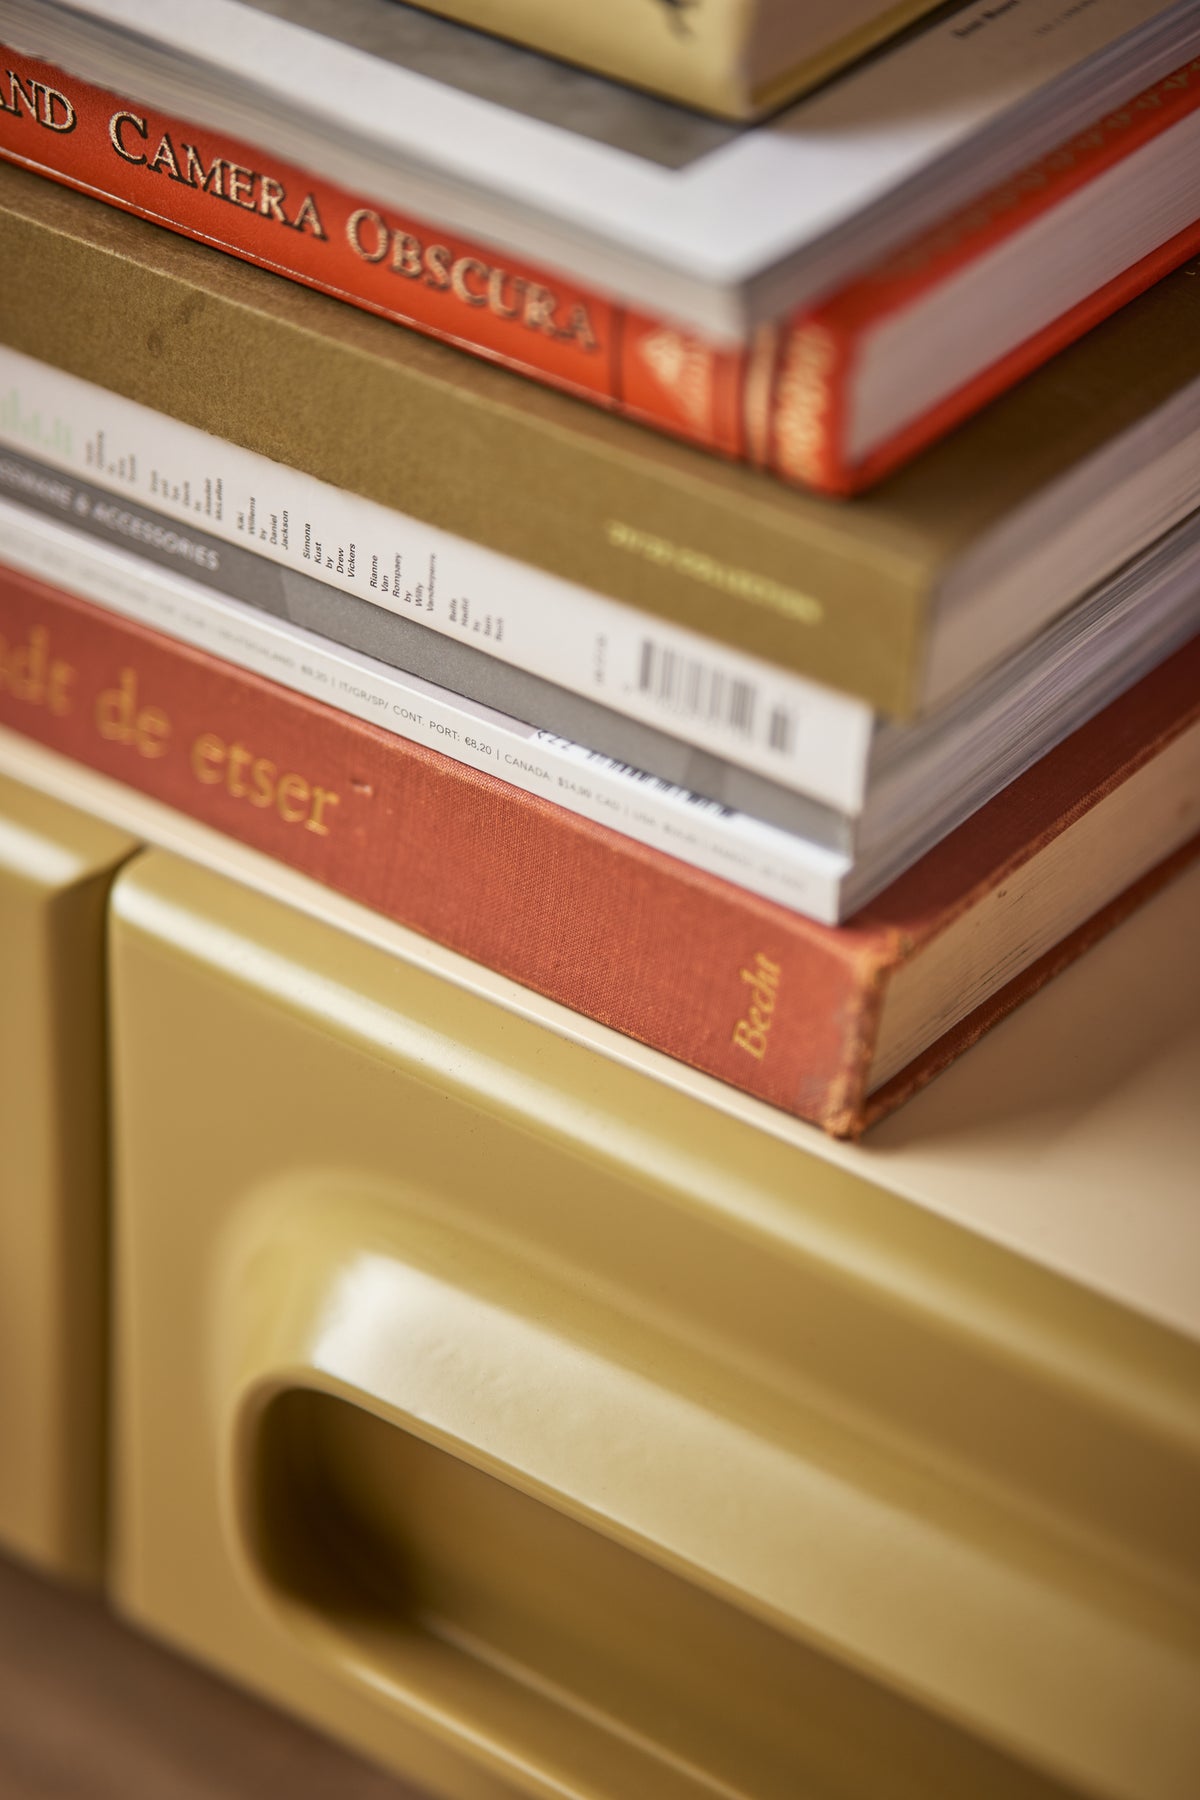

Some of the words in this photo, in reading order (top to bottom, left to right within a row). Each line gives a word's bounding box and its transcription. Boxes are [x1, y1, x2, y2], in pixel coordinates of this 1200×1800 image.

[108, 111, 329, 241] CAMERA
[345, 208, 598, 350] OBSCURA
[248, 496, 256, 535] Willems
[269, 513, 278, 545] Daniel
[281, 510, 289, 550] Jackson
[93, 502, 220, 571] ACCESSORIES
[259, 528, 268, 541] by
[302, 523, 311, 560] Simona
[314, 542, 322, 564] Kust
[325, 556, 334, 569] by
[336, 547, 344, 574] Drew
[347, 543, 356, 578] Vickers
[369, 554, 378, 589] Rianne
[380, 575, 389, 592] Van
[392, 552, 402, 598] Rompaey
[403, 590, 412, 603] by
[415, 582, 424, 607] Willy
[94, 666, 172, 759] de
[191, 732, 341, 837] etser
[393, 704, 425, 727] CONT.
[429, 719, 460, 742] PORT:
[504, 752, 553, 781] CANADA:
[732, 952, 782, 1061] Becht
